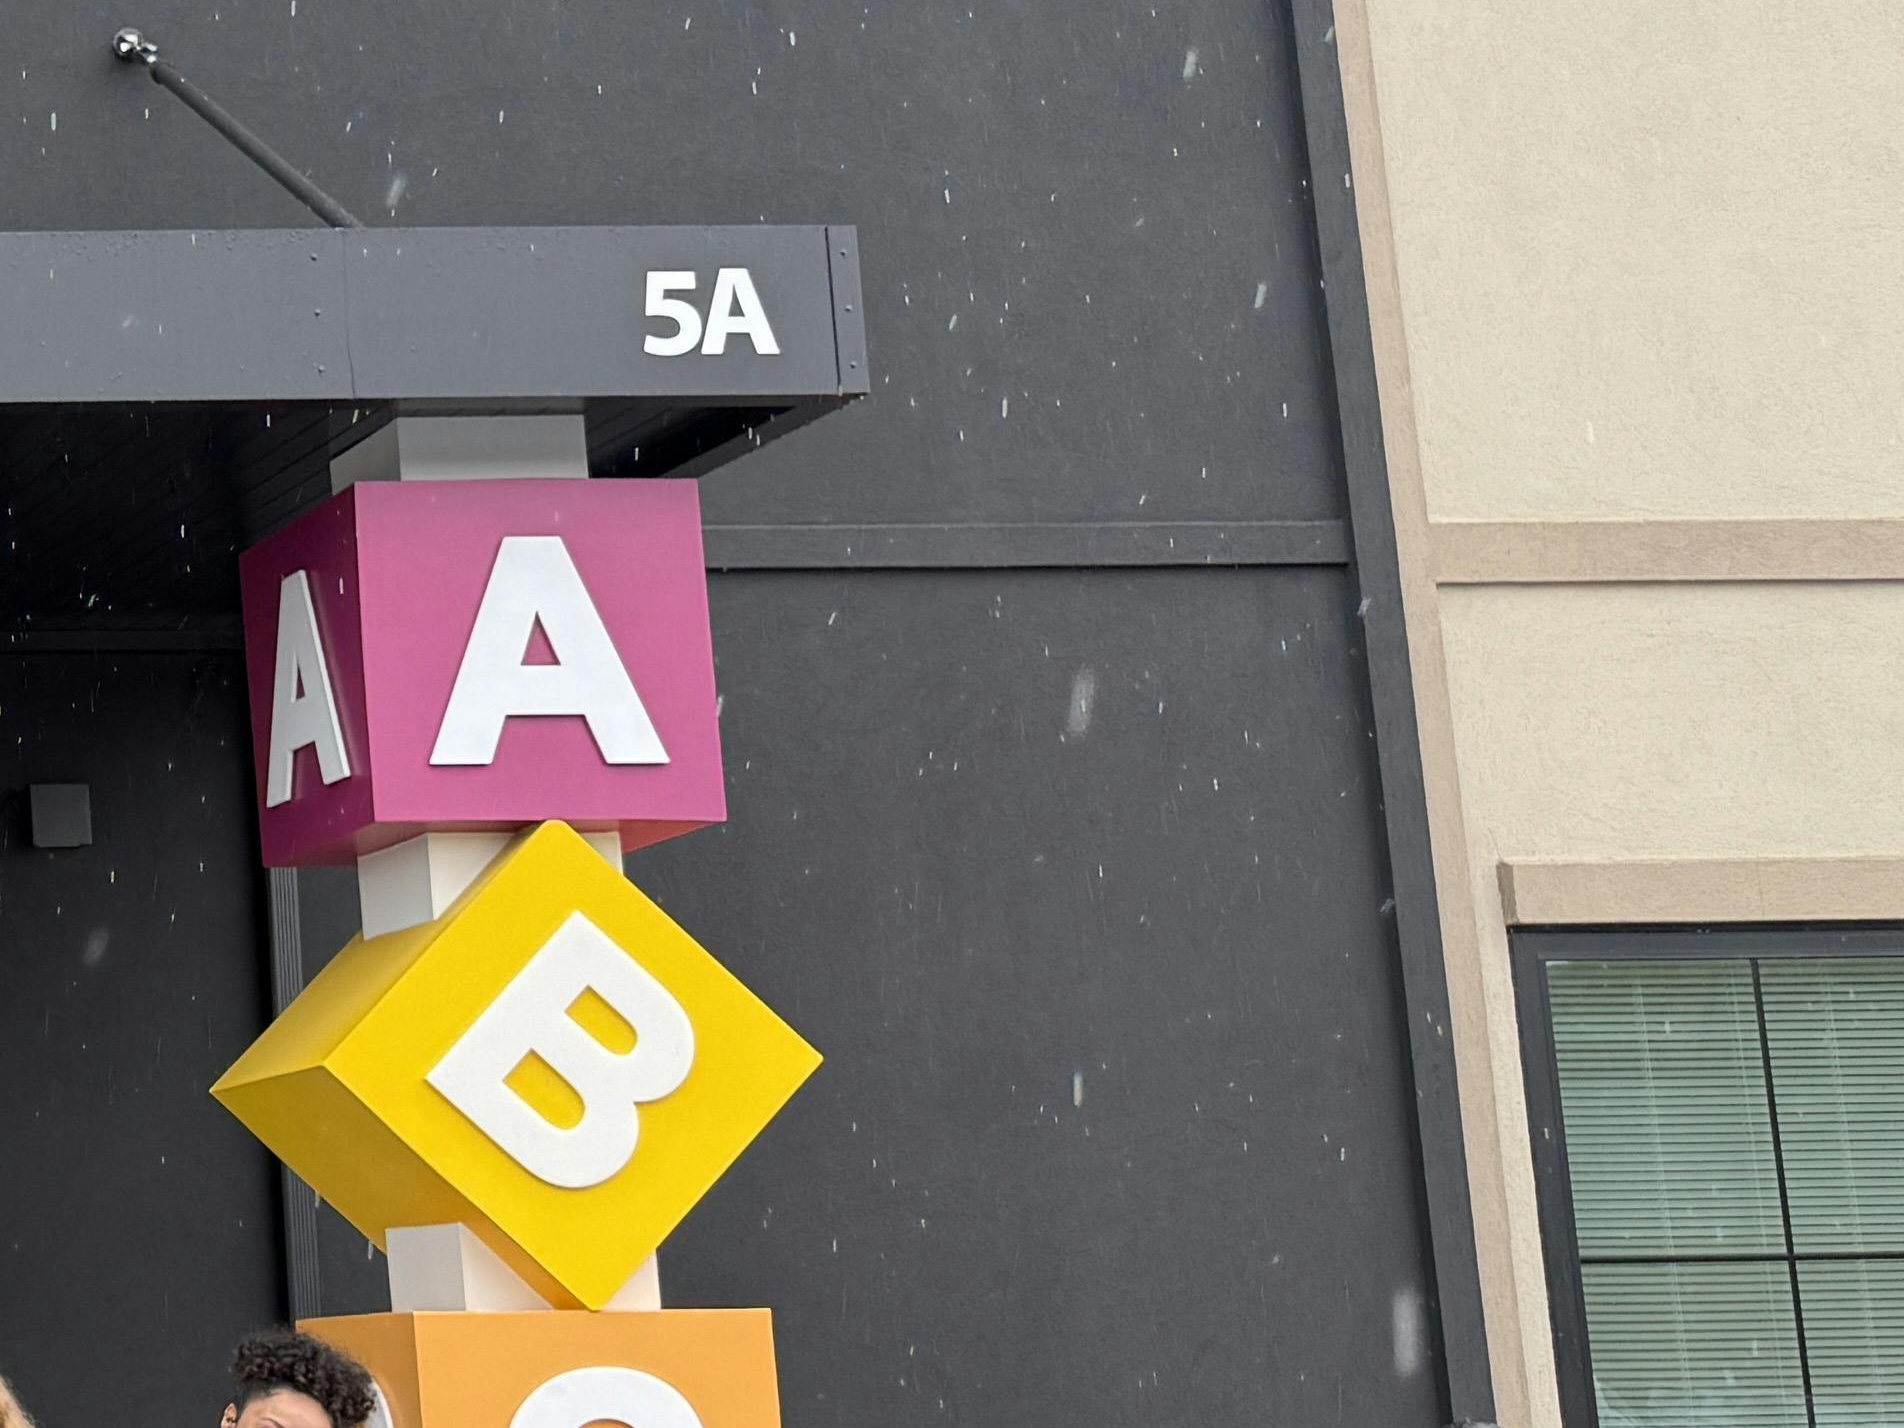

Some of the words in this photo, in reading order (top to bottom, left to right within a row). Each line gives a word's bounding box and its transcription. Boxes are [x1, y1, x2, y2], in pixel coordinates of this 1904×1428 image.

[643, 267, 782, 357] 5A
[266, 569, 352, 810] A
[428, 535, 672, 766] A
[424, 908, 696, 1189] B
